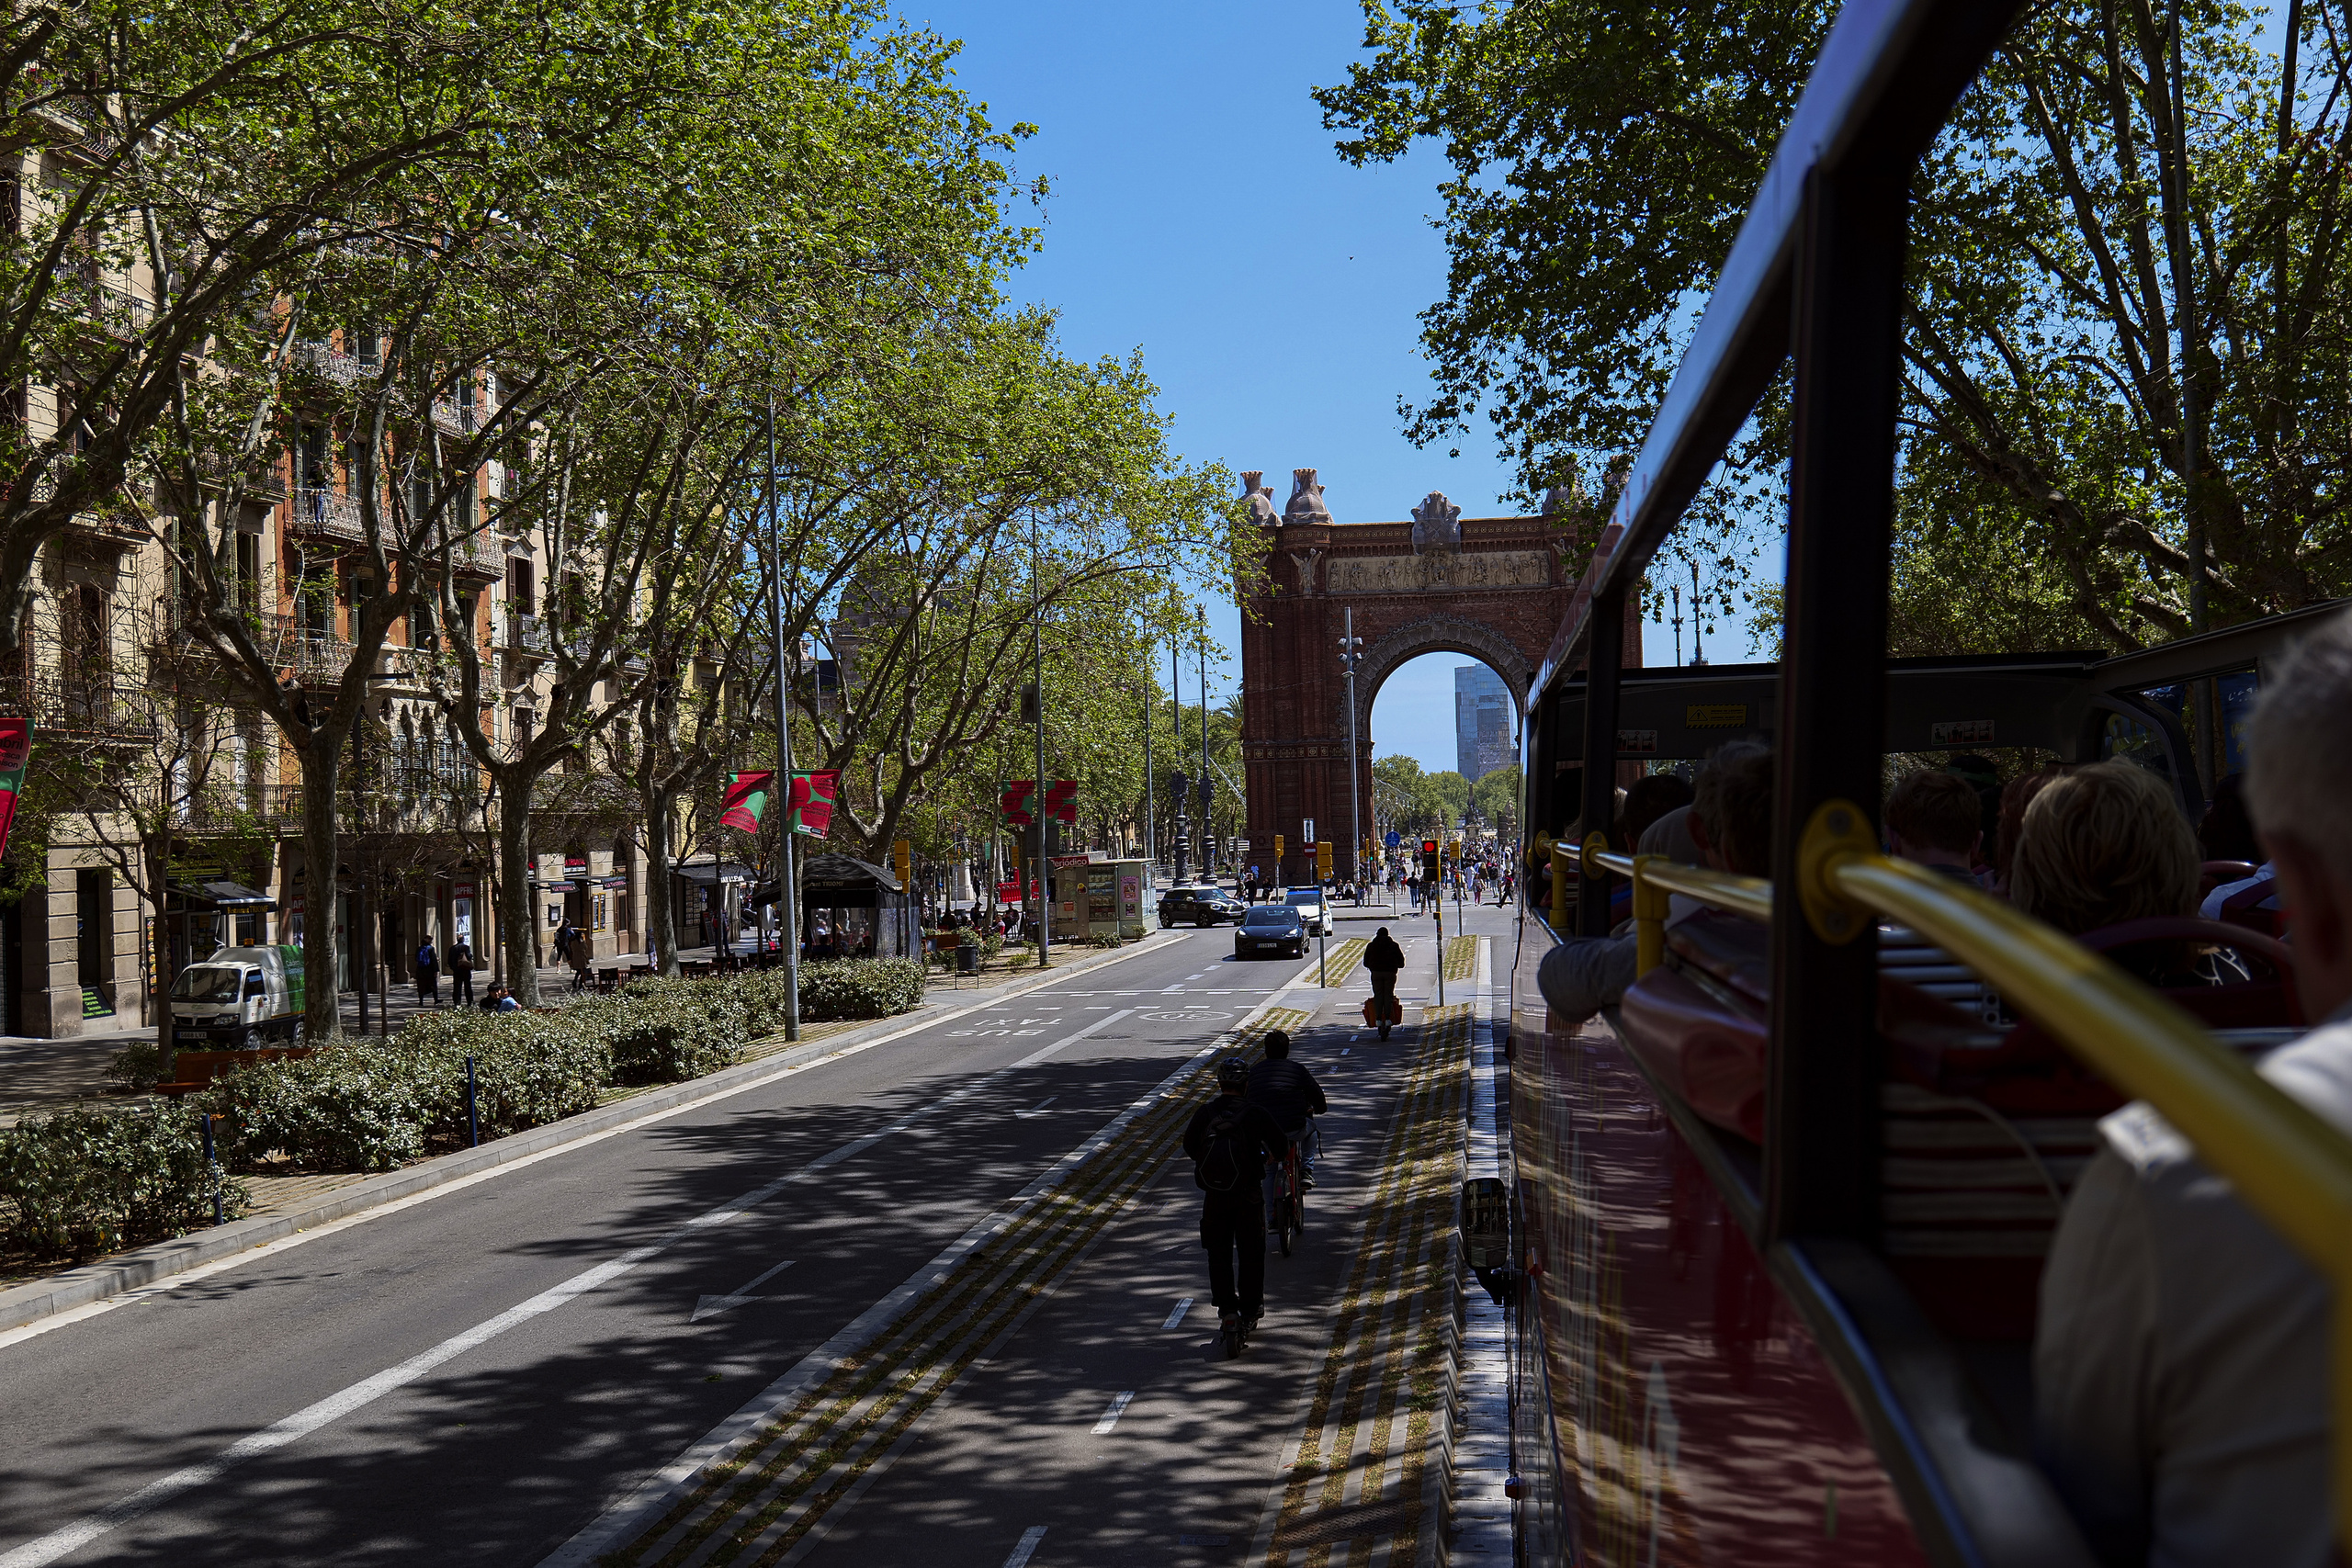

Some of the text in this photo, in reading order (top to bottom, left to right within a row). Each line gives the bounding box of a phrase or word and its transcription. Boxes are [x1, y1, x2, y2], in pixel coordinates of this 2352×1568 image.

[456, 886, 474, 895] APFRE
[974, 1018, 1062, 1026] TAXI
[944, 1029, 1046, 1037] BUS
